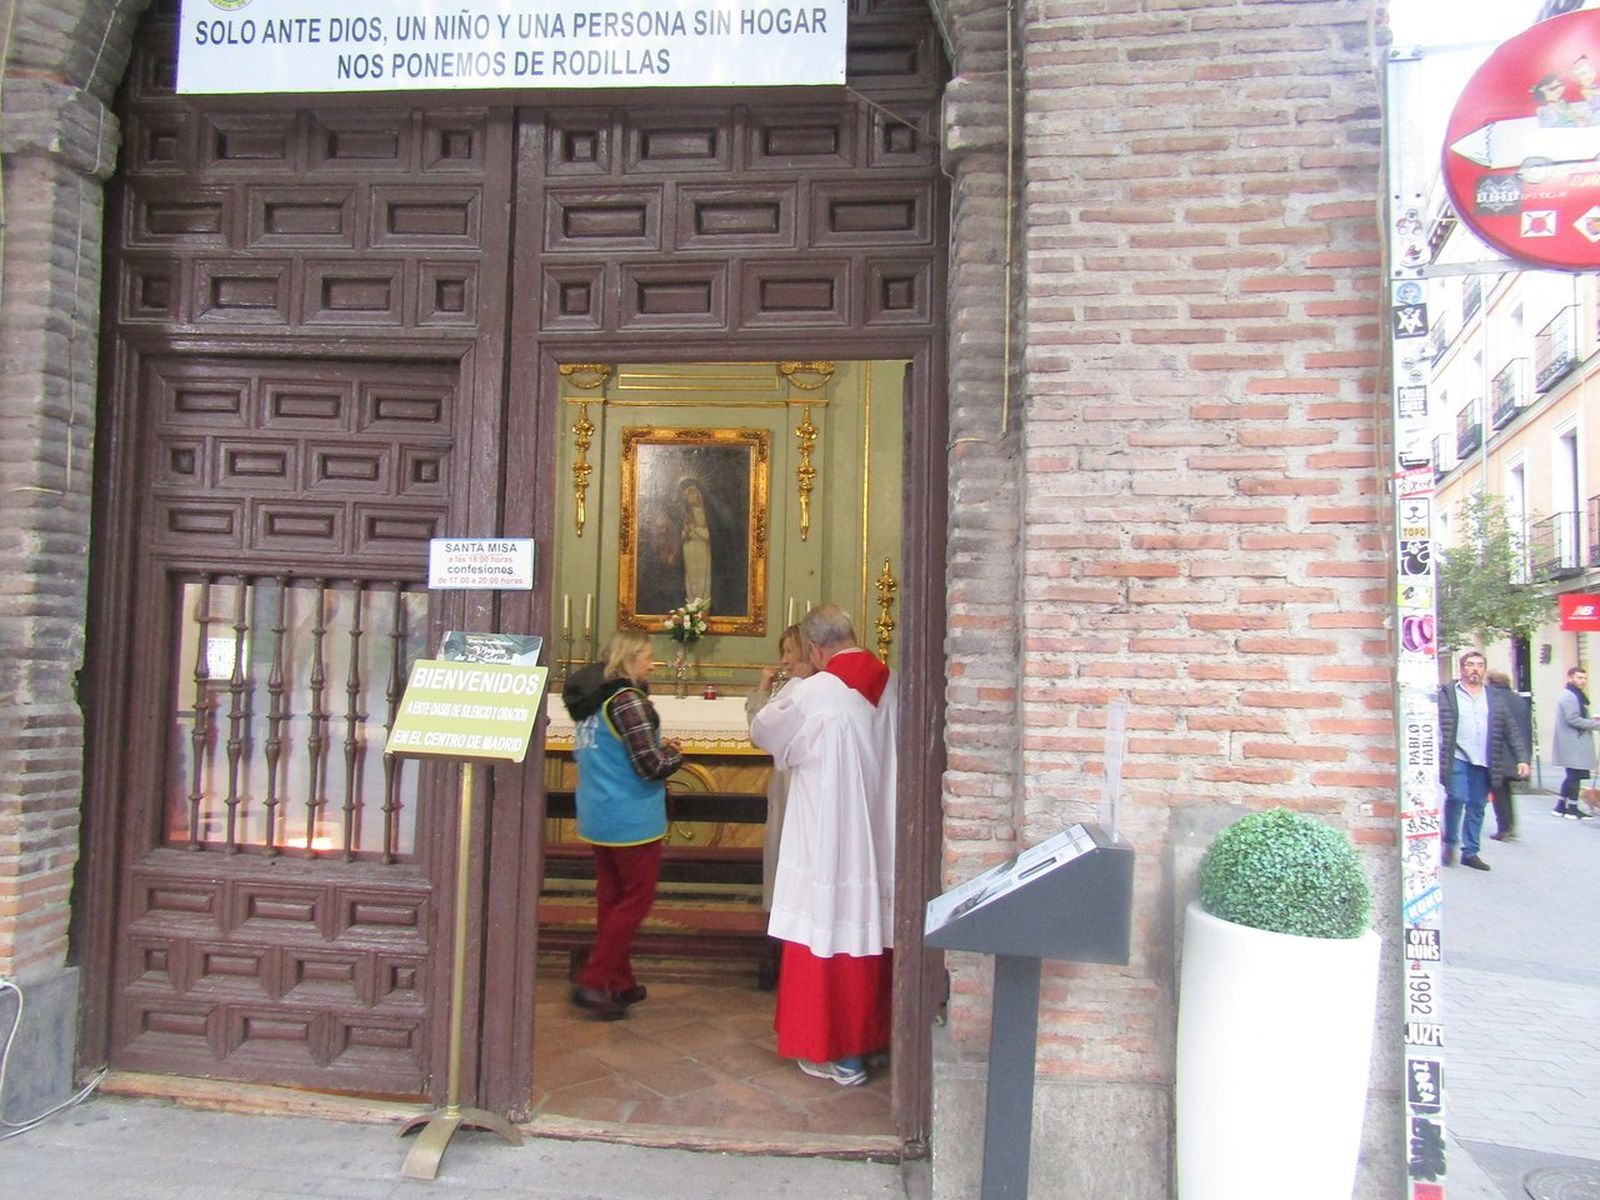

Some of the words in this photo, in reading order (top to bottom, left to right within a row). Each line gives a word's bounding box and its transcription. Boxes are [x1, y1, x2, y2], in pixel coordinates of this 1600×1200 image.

[195, 19, 256, 45] SOLO
[262, 18, 321, 44] ANTE
[329, 16, 388, 46] DIOS,
[396, 16, 426, 41] UN
[434, 8, 490, 40] NIÑO
[497, 14, 511, 39] Y
[518, 13, 566, 39] UNA
[573, 11, 687, 38] PERSONA
[694, 9, 731, 36] SIN
[740, 8, 827, 35] HOGAR
[337, 53, 384, 79] NOS
[392, 50, 506, 79] PONEMOS
[514, 51, 545, 76] DE
[552, 48, 671, 76] RODILLAS
[445, 543, 485, 553] SANTA
[487, 543, 518, 553] MISA
[447, 564, 514, 575] confesiones
[500, 577, 523, 585] horas
[411, 667, 540, 696] BIENVENIDOS
[393, 729, 410, 744] EN
[410, 730, 422, 745] EL
[424, 731, 466, 748] CENTRO
[465, 734, 482, 750] DE
[482, 735, 522, 752] MADRID
[1409, 929, 1436, 945] OYE
[1409, 973, 1433, 1015] 1992
